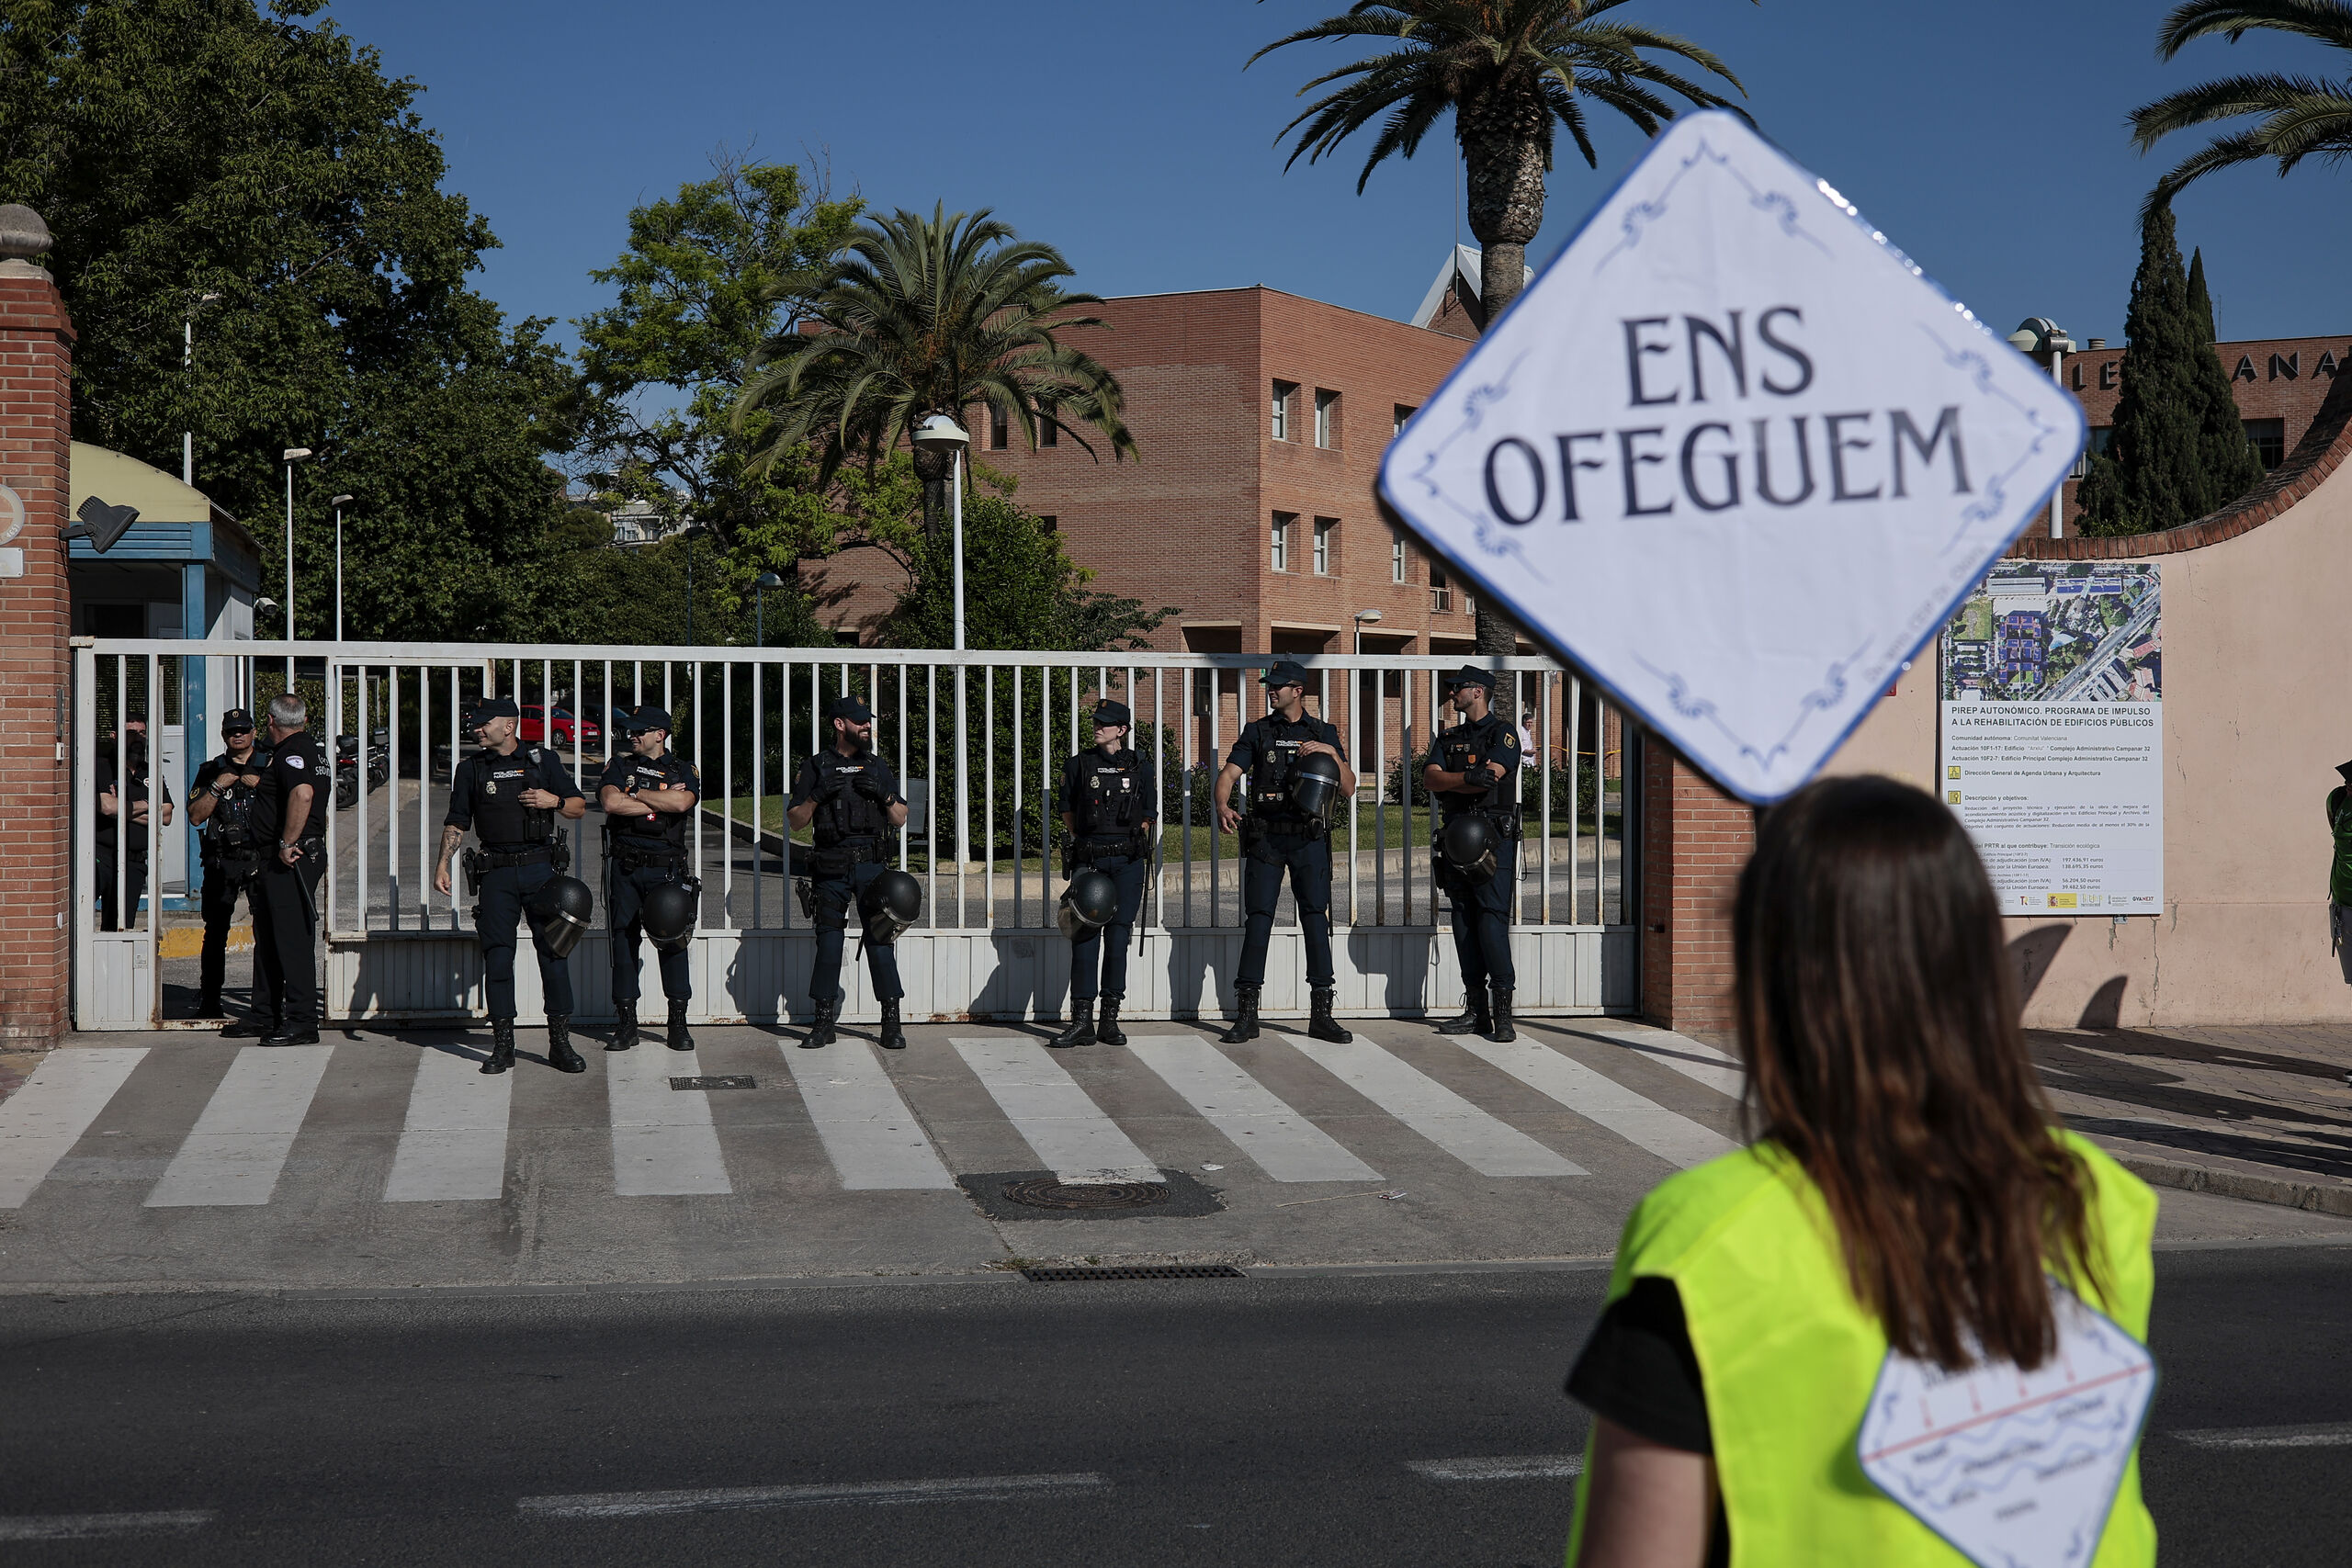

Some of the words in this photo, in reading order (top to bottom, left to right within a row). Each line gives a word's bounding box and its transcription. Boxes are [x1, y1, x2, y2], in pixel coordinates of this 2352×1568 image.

[1621, 306, 1815, 409] ENS
[1483, 402, 1974, 526] OFEGUEM
[1952, 707, 1978, 715] PIREP
[1980, 705, 2042, 715] AUTONÓMICO.
[2045, 707, 2096, 715] PROGRAMA
[2098, 707, 2109, 715] DE
[2112, 707, 2151, 715] IMPULSO
[1974, 717, 2047, 726] REHABILITACIÓN
[2110, 717, 2154, 727] PÚBLICOS
